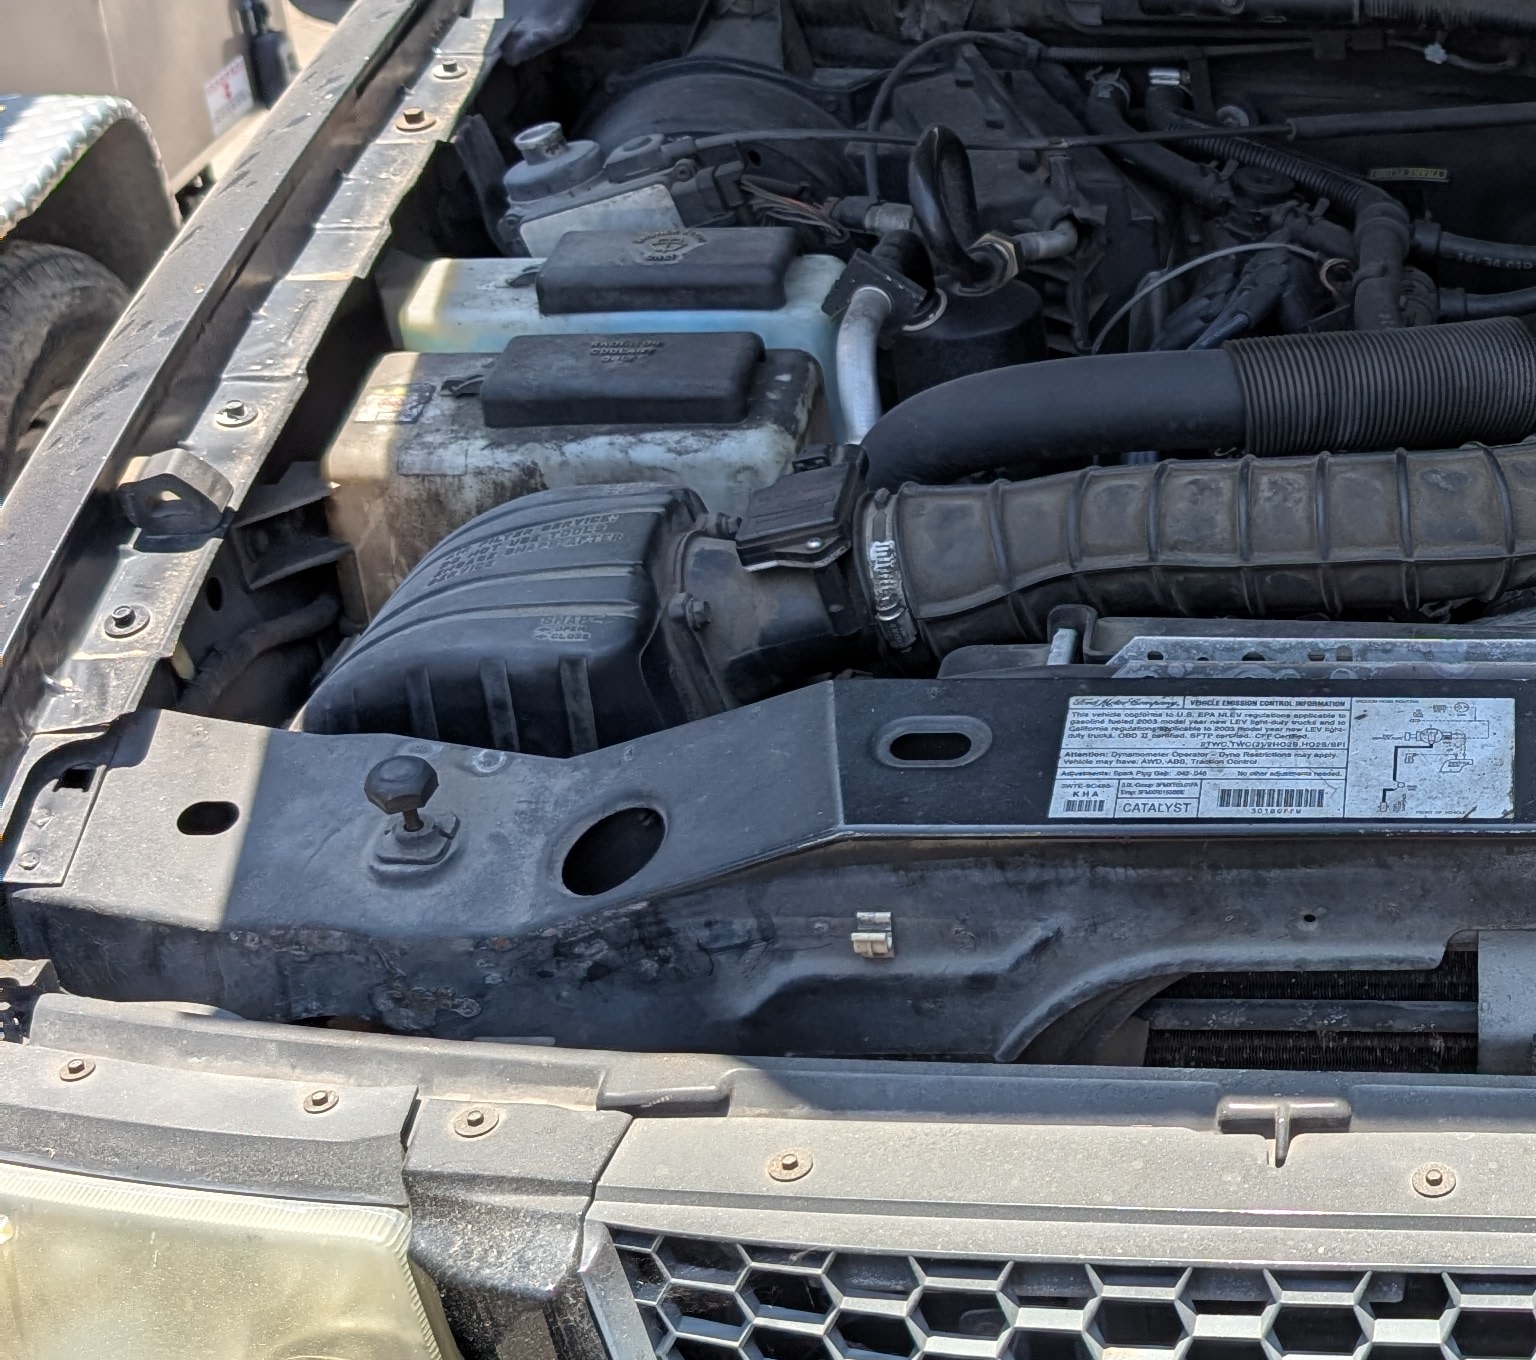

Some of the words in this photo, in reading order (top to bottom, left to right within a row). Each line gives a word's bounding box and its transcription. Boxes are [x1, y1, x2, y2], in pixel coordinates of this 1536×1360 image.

[509, 533, 542, 547] USE
[550, 523, 607, 540] TOOLS
[541, 614, 590, 626] SNAP
[554, 625, 587, 633] OPEN
[550, 632, 591, 640] CLOSE
[1072, 698, 1098, 708] Ford
[1096, 698, 1129, 708] Motor
[1122, 802, 1192, 813] CATALYST
